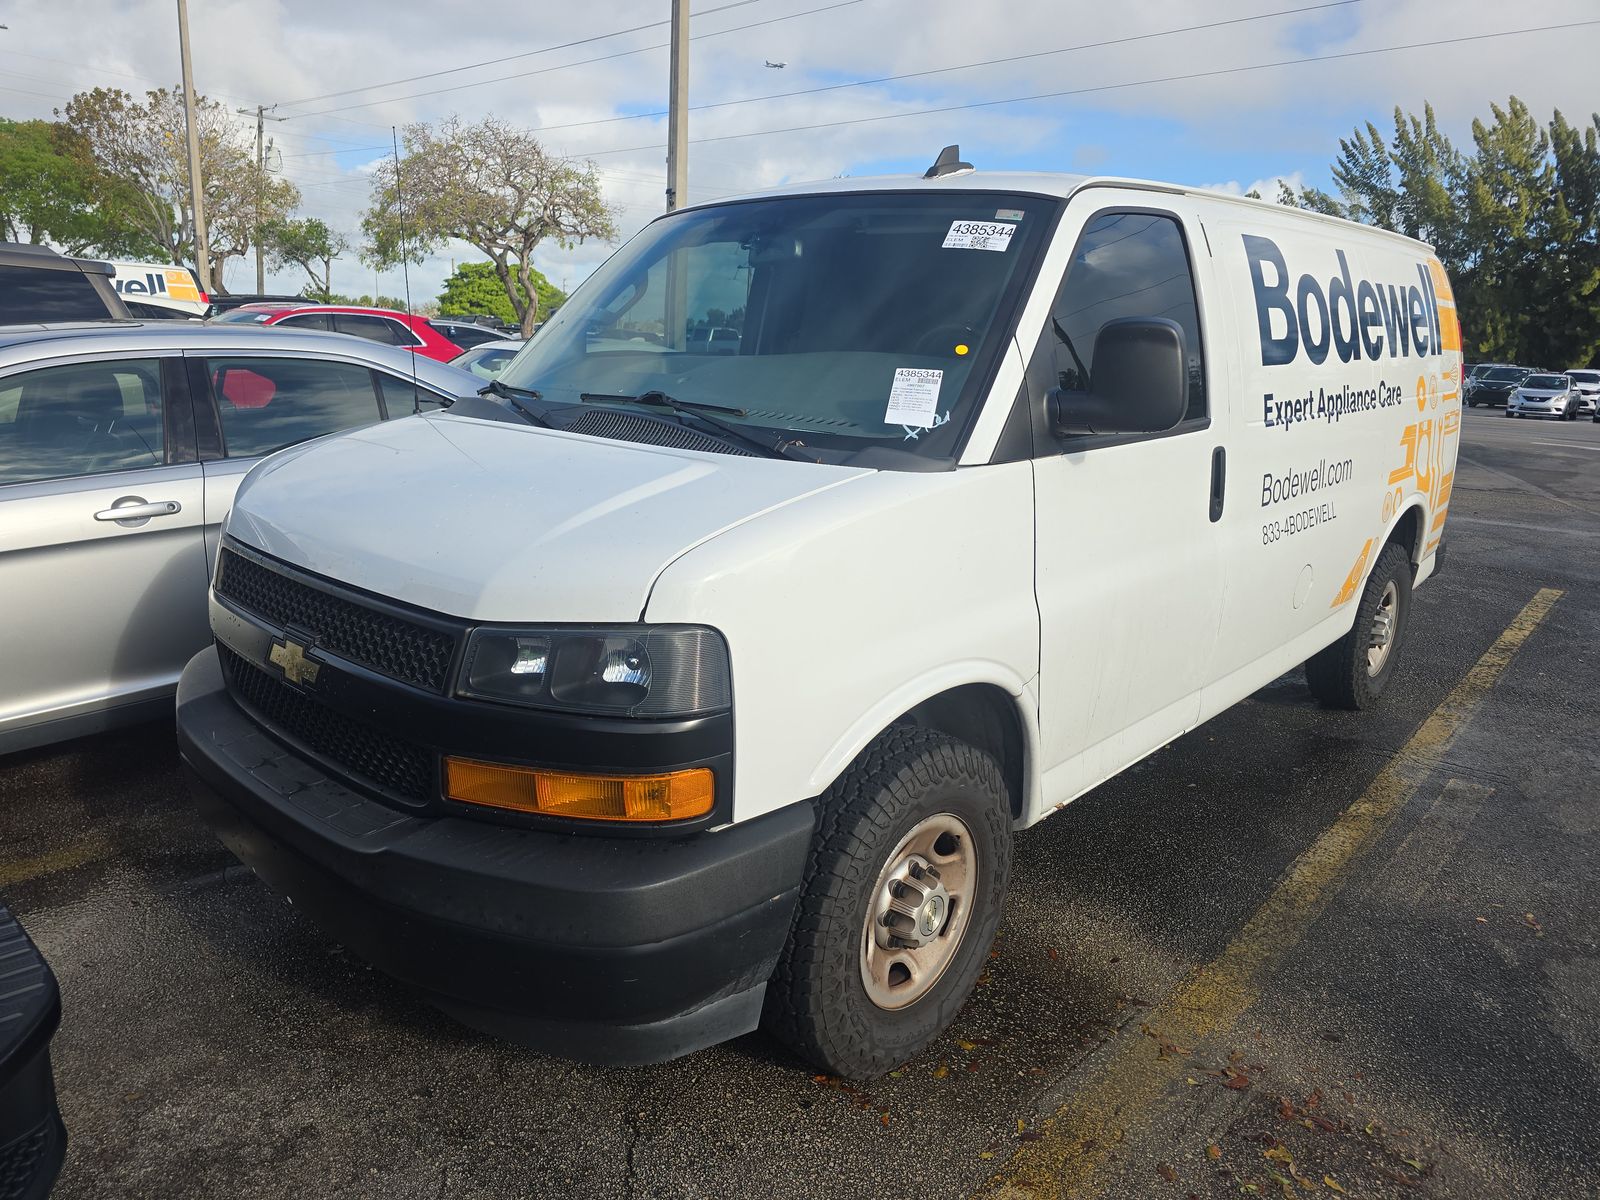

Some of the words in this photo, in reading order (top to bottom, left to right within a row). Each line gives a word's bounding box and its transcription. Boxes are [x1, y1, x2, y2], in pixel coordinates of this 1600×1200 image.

[953, 224, 1014, 238] 4385344
[1241, 233, 1443, 366] Bodewell
[898, 370, 942, 379] 4385344
[1263, 390, 1315, 431] Expert
[1317, 384, 1377, 424] Appliance
[1378, 380, 1402, 410] Care
[1261, 458, 1353, 508] Bodewell.com
[1262, 501, 1337, 546] 833-4BODEWELL
